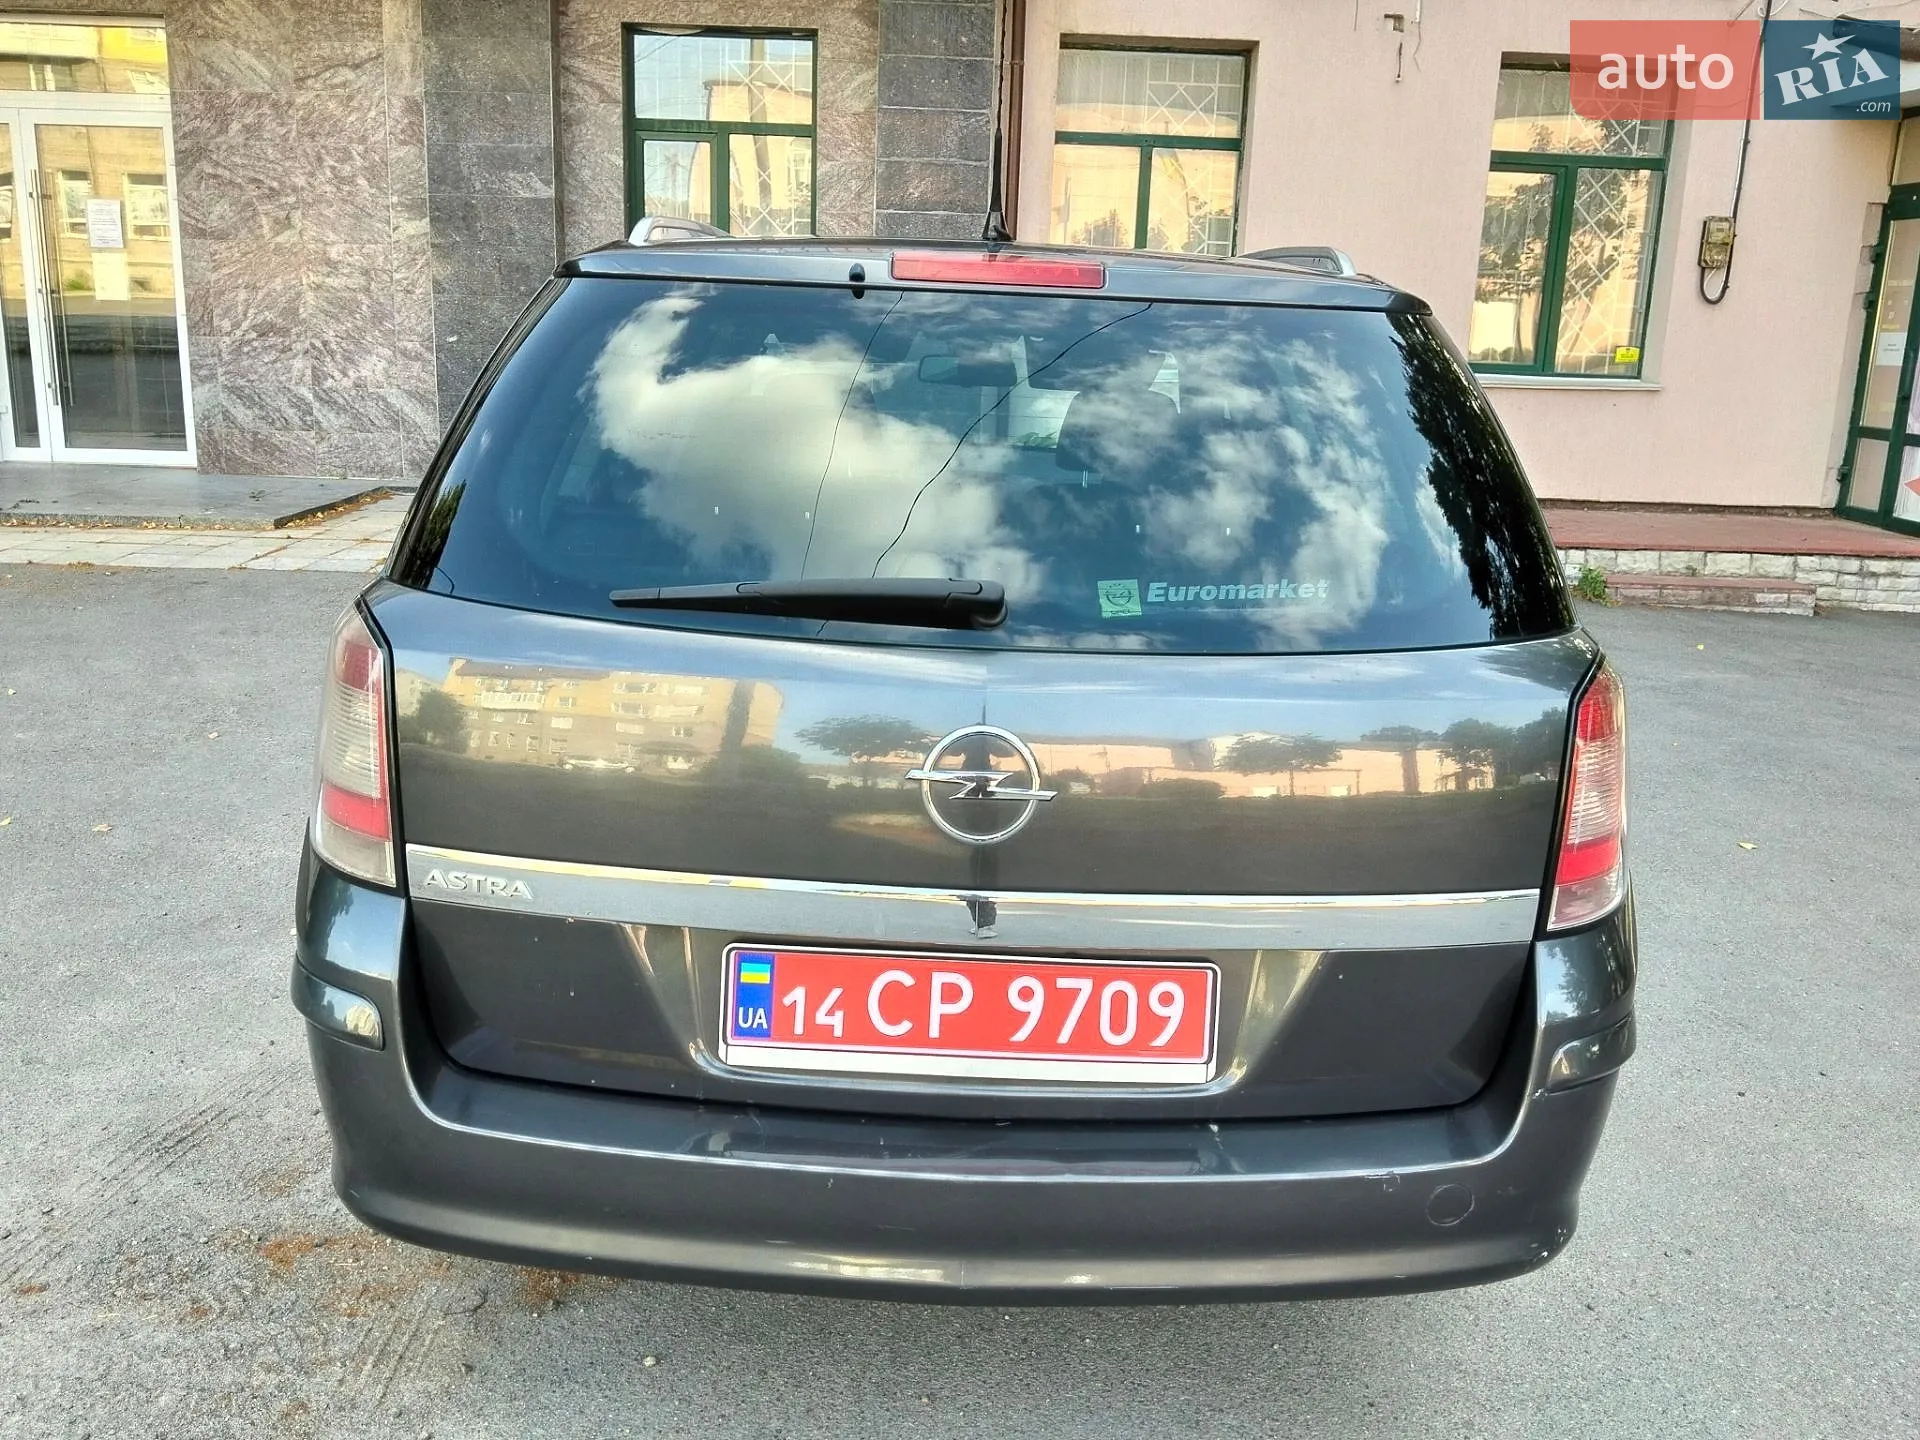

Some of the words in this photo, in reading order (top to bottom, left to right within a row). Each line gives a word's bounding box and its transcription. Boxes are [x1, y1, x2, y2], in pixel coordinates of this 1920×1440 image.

[1146, 579, 1329, 603] Euromarket
[426, 868, 534, 900] ASTRA
[738, 1006, 767, 1030] UA
[782, 986, 845, 1038] 14
[866, 969, 974, 1039] CP
[1006, 974, 1186, 1047] 9709
